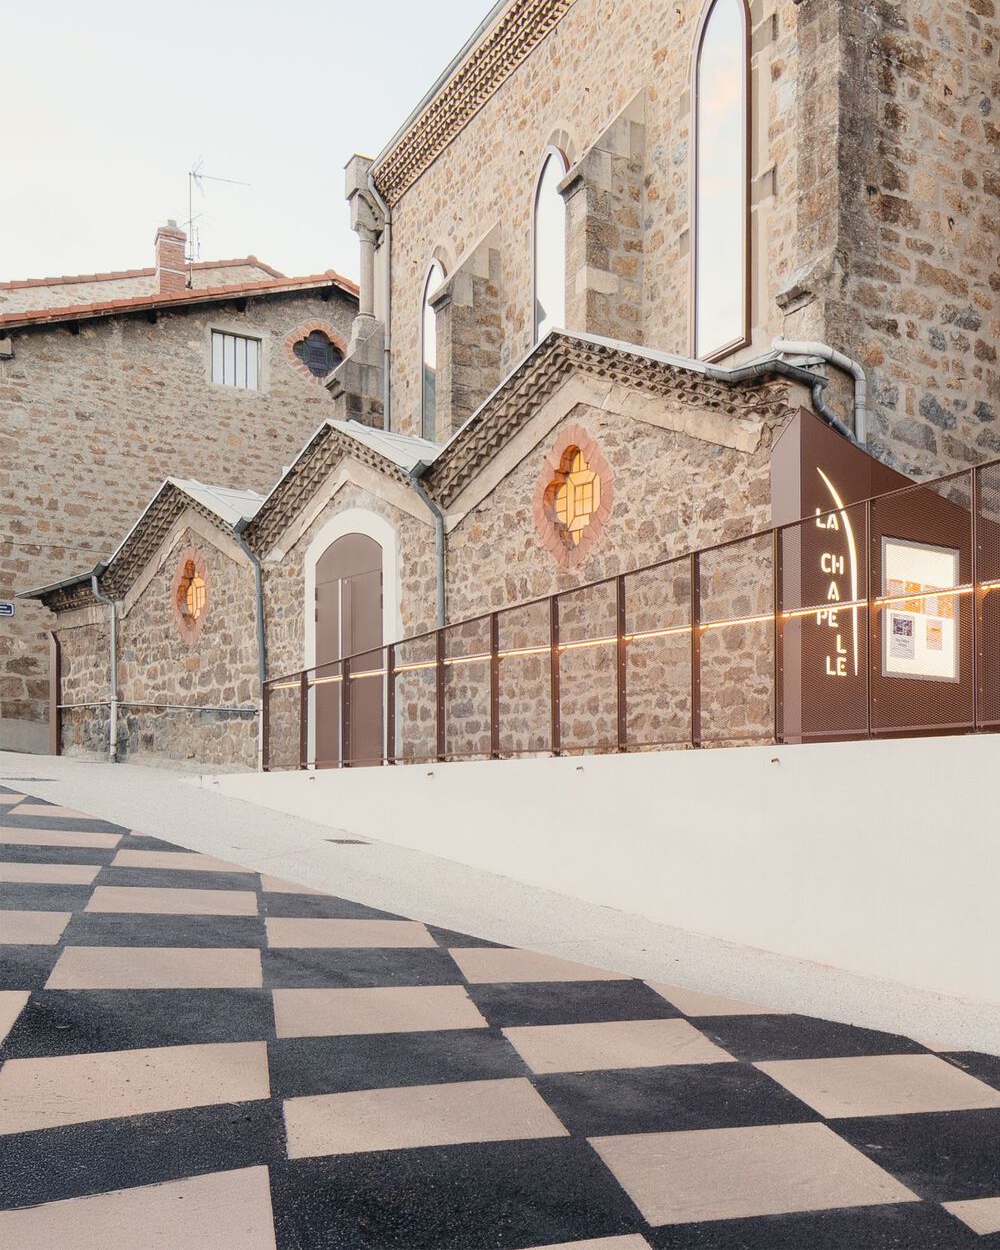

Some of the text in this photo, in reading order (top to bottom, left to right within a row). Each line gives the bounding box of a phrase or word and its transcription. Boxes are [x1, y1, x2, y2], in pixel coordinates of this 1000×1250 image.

[815, 507, 839, 531] LA
[820, 552, 844, 575] CH
[828, 581, 840, 601] A
[836, 634, 847, 654] L
[826, 656, 848, 677] LE
